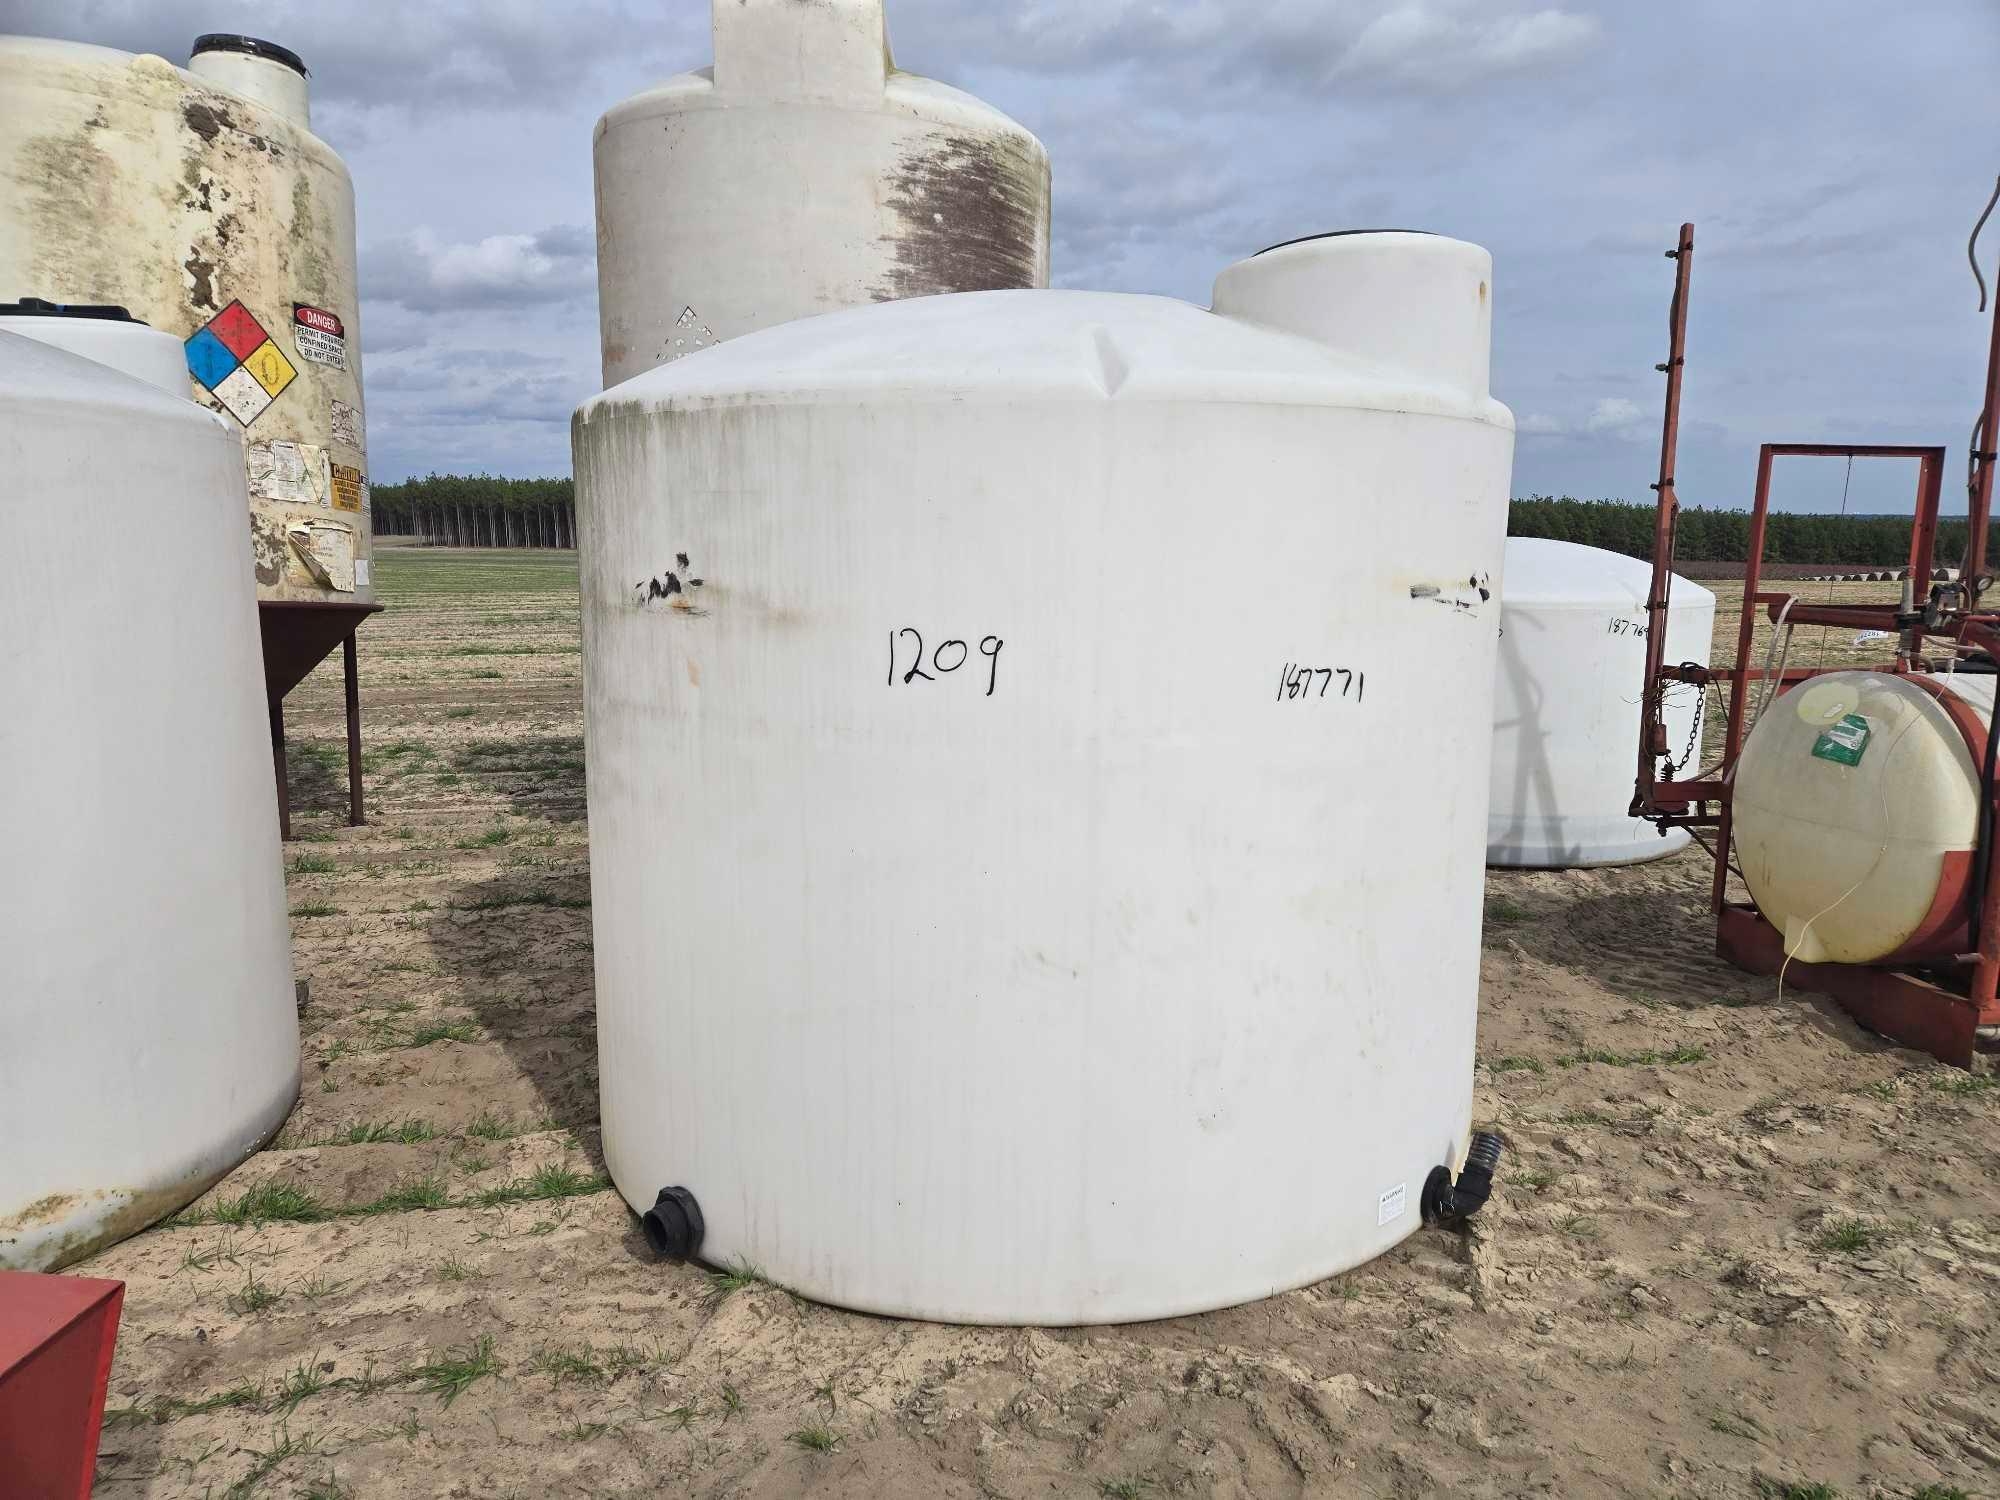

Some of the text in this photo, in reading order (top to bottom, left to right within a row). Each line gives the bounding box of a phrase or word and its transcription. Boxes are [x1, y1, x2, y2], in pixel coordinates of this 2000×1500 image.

[307, 310, 336, 331] DANGER
[297, 326, 319, 339] PERMIT
[299, 336, 328, 350] CONFINED
[304, 348, 313, 357] DO
[314, 351, 325, 360] NOT
[887, 627, 1004, 697] 1209
[1277, 662, 1364, 703] 187771
